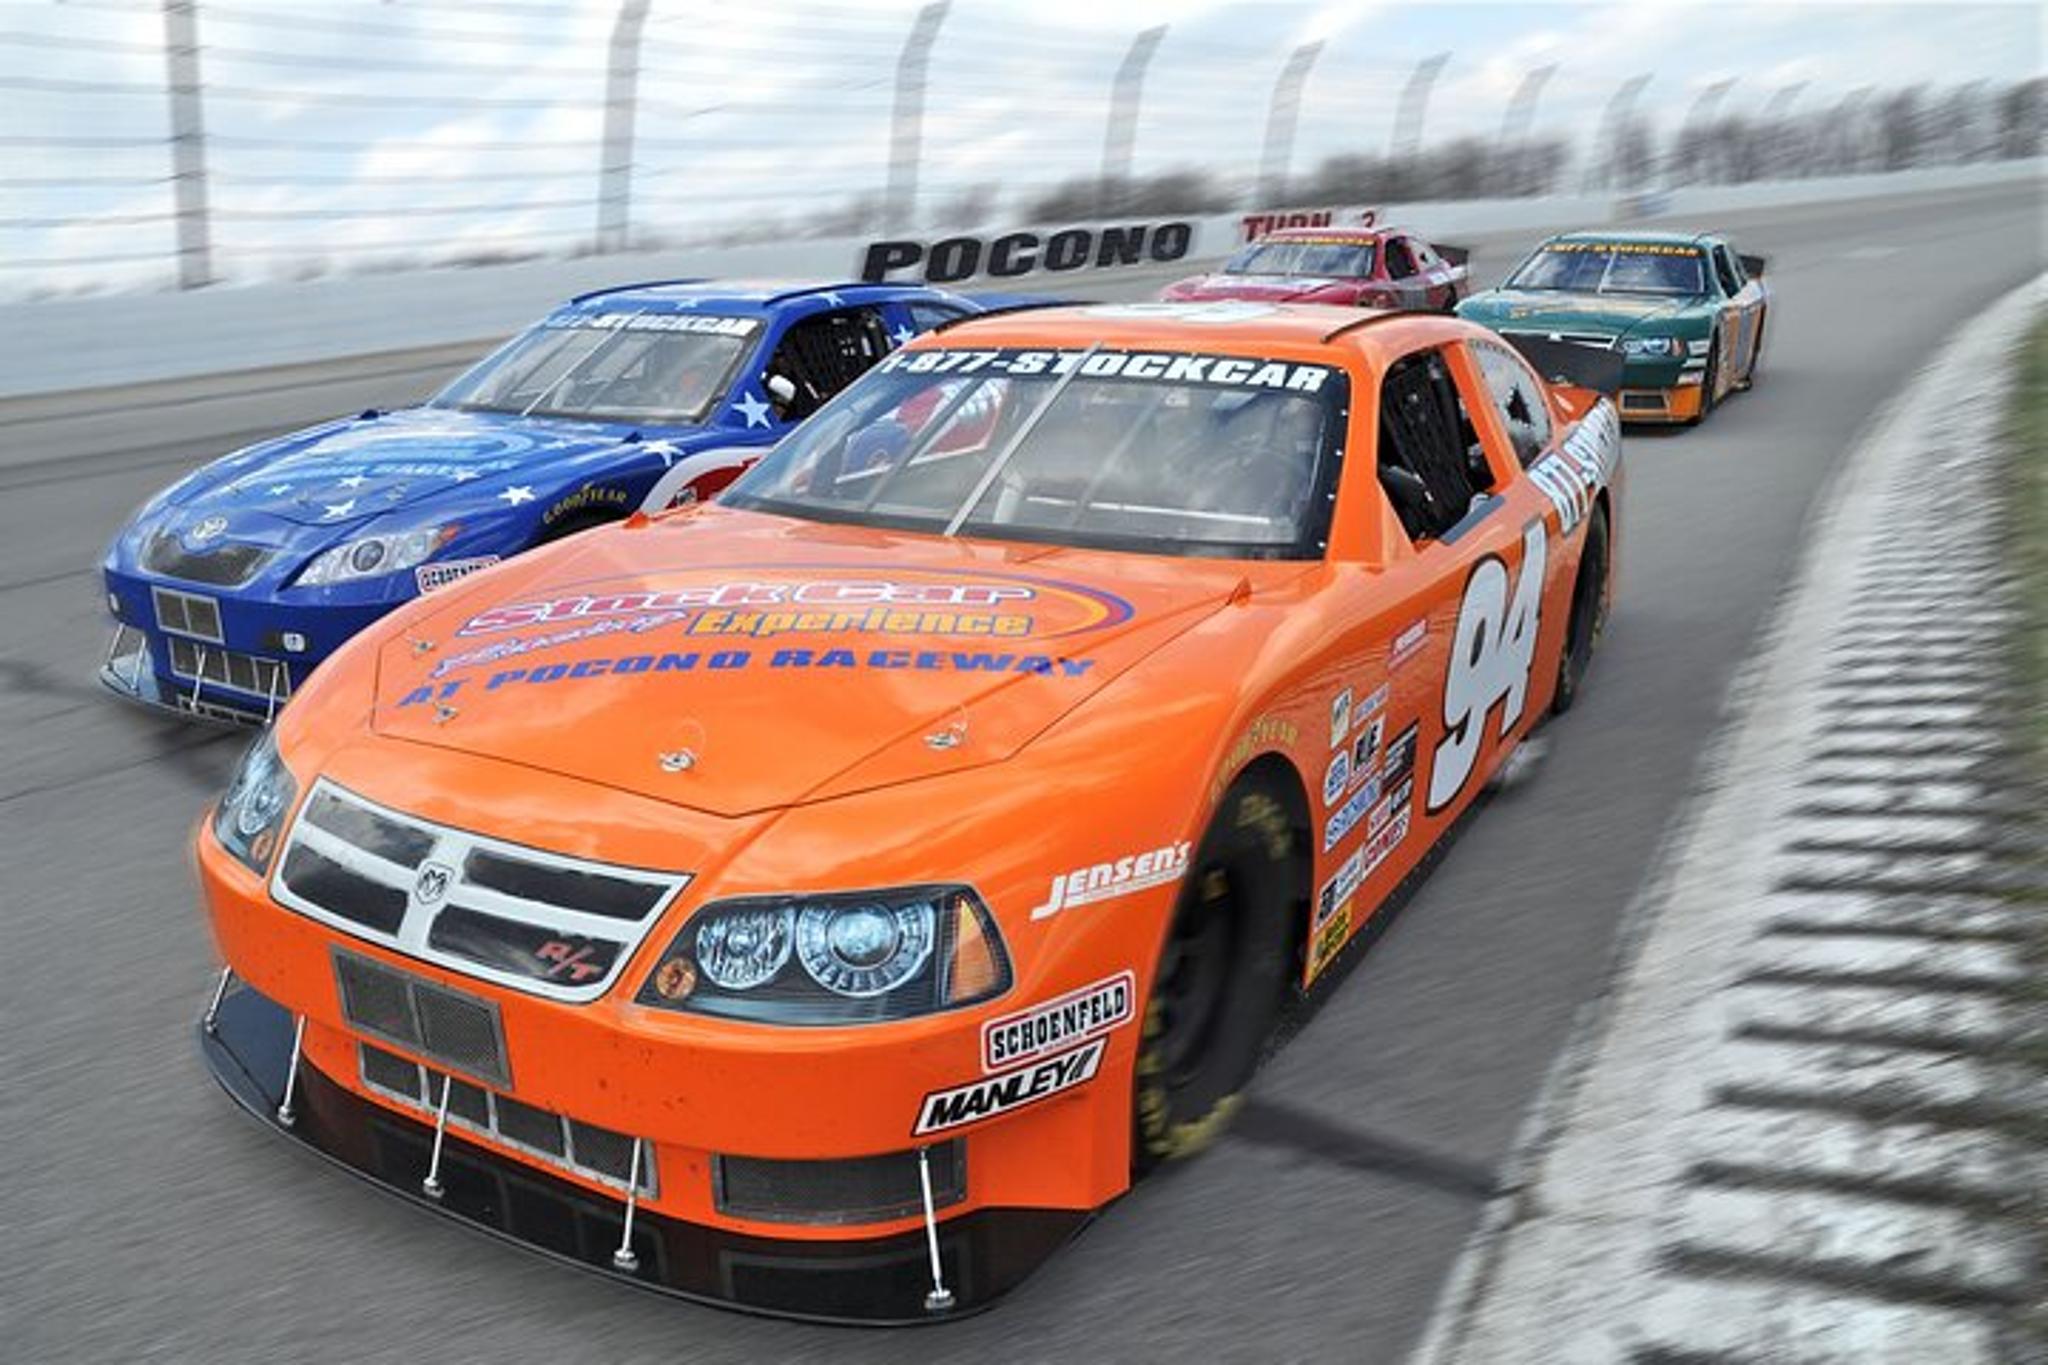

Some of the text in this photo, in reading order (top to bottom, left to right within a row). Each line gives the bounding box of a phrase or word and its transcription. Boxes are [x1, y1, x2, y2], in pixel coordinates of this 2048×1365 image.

[861, 222, 1193, 283] POCONO
[879, 351, 1330, 392] 1-877-STOCKCAR
[396, 649, 1097, 707] AT POCONO RACEWAY
[1425, 514, 1547, 815] 94
[992, 985, 1125, 1060] SCHOENFELD
